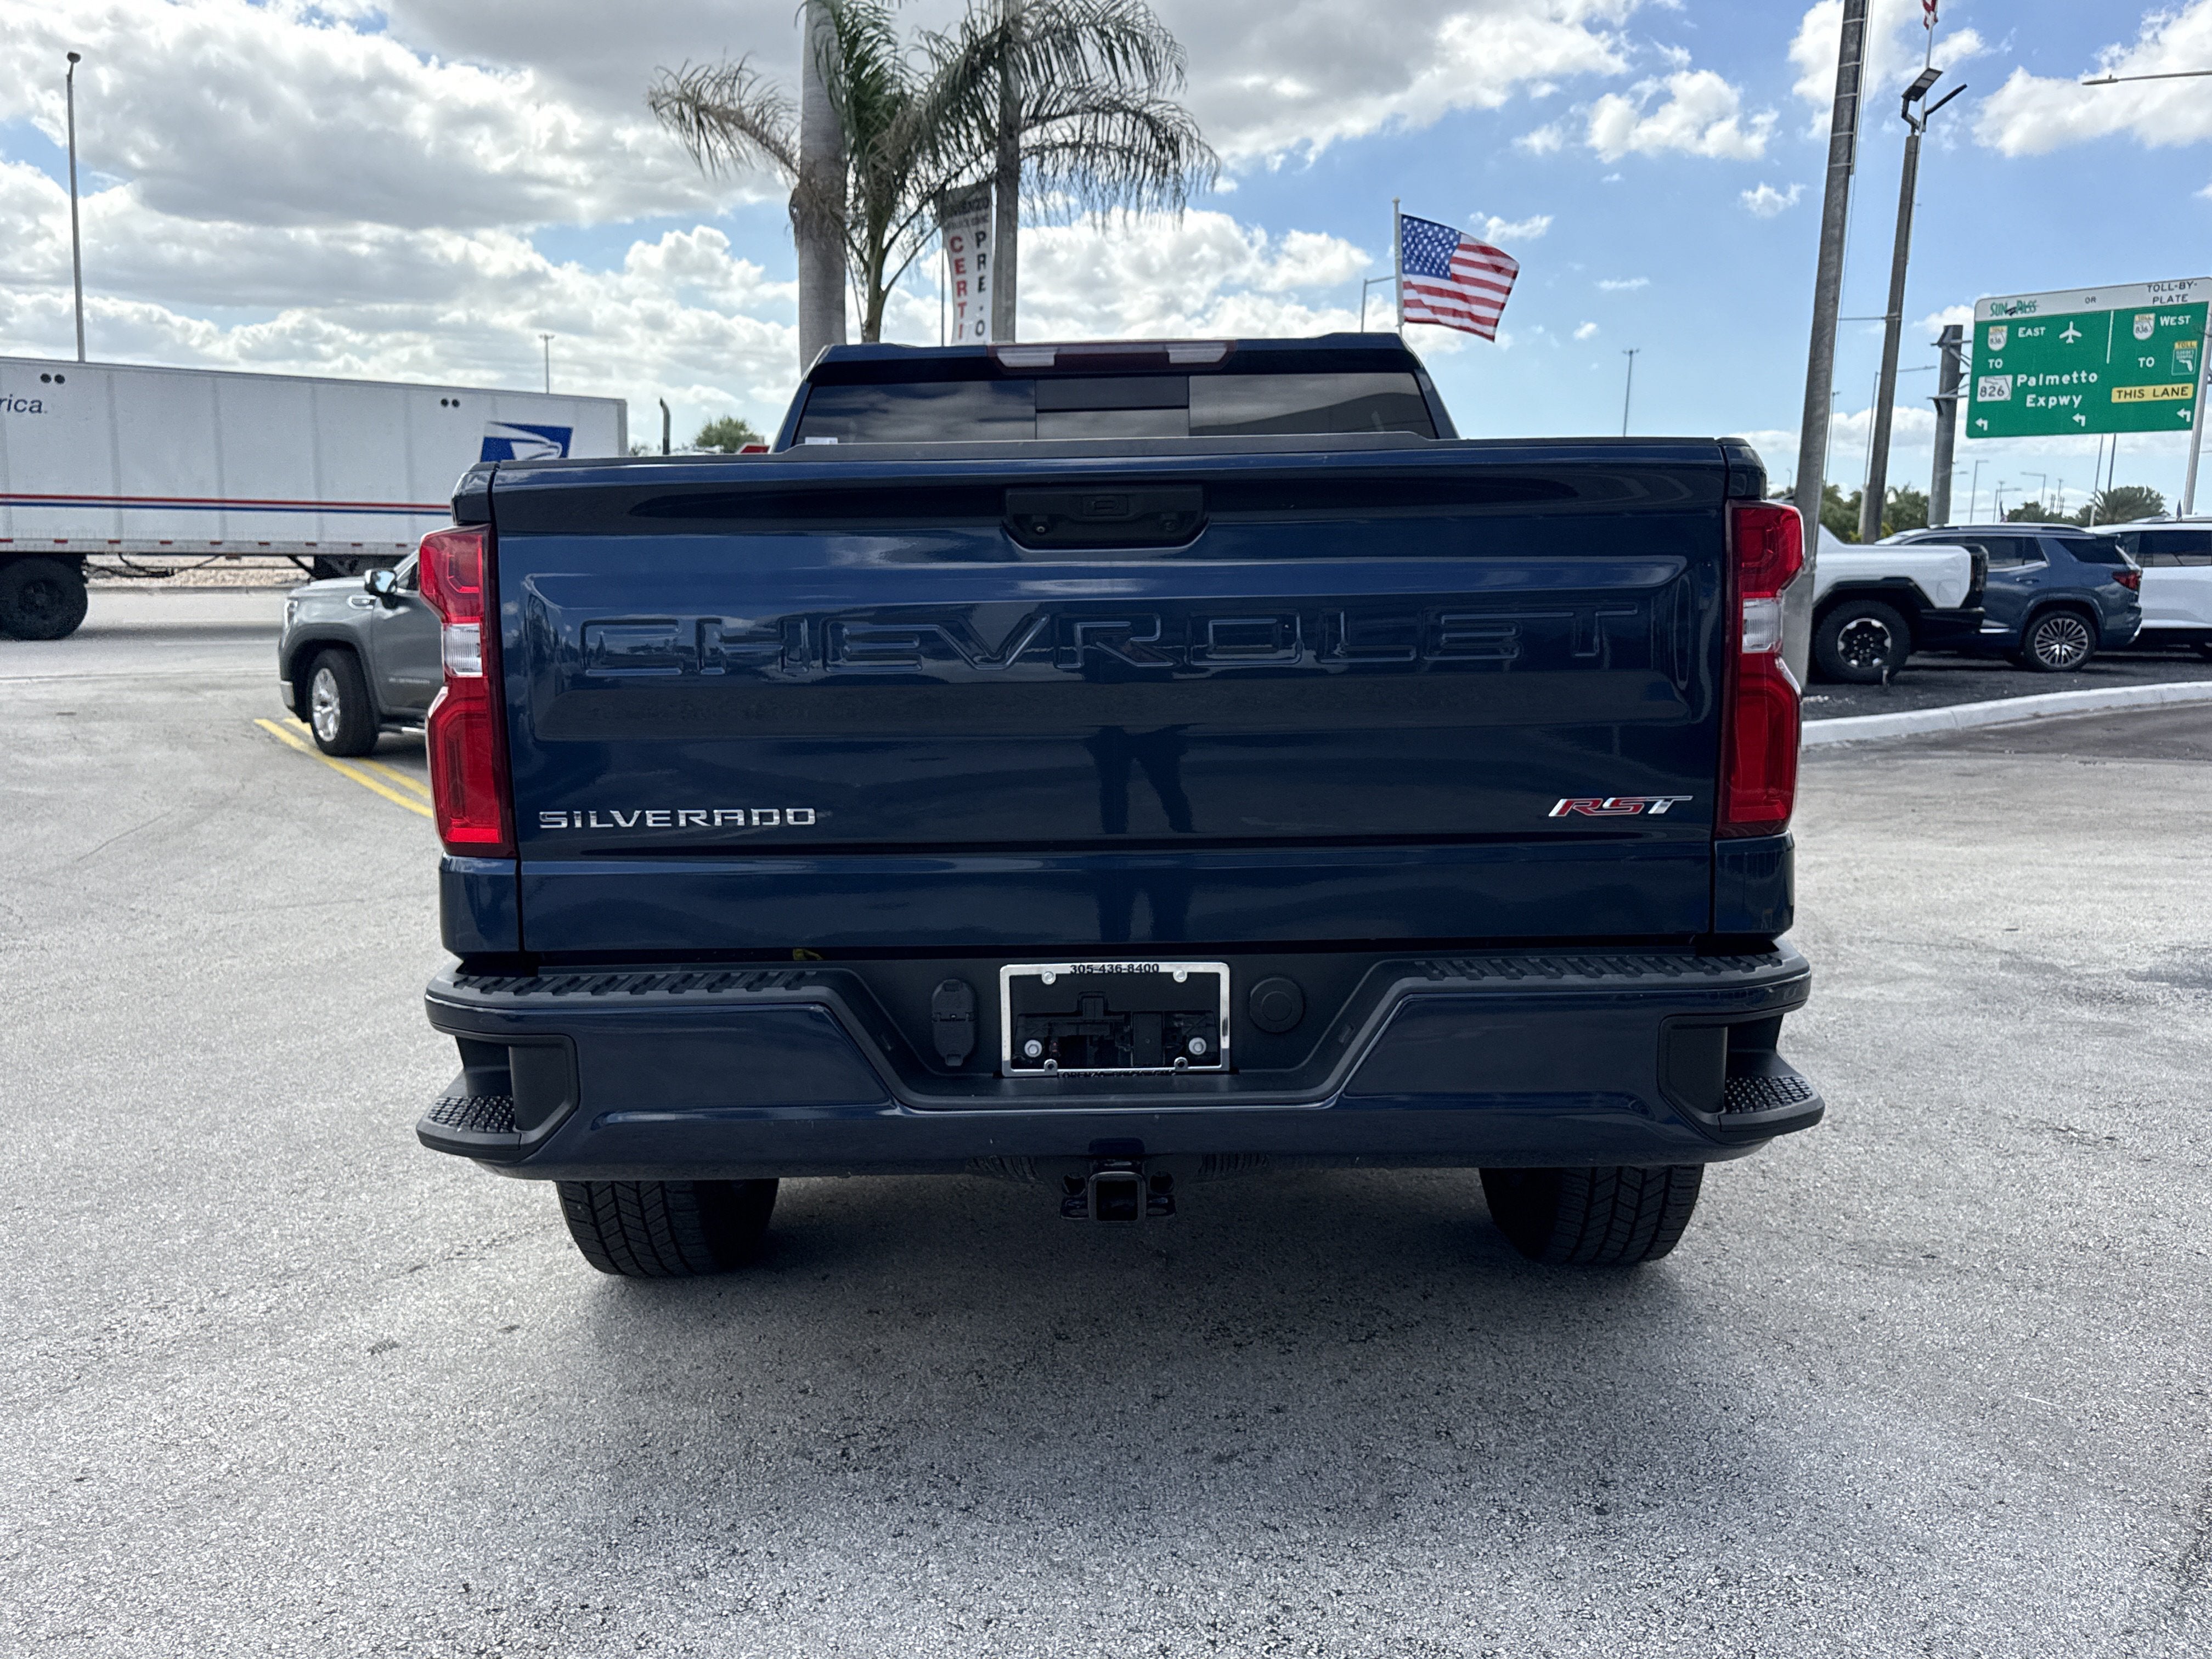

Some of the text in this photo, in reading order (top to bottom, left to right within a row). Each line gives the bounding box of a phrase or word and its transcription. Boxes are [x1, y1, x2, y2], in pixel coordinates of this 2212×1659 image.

[2153, 294, 2188, 304] PLATE
[2160, 314, 2192, 326] WEST
[2018, 326, 2046, 337] EAST
[1988, 358, 2003, 369] TO
[2138, 357, 2155, 368] TO
[2017, 370, 2098, 387] Palmetto
[1979, 386, 2005, 397] 826
[2117, 386, 2188, 399] THIS LANE
[2026, 394, 2082, 409] Expwy
[579, 602, 1640, 676] CHEVROLET
[1548, 795, 1693, 816] RST
[539, 808, 816, 828] SILVERADO
[1070, 963, 1160, 974] 305-436-8400
